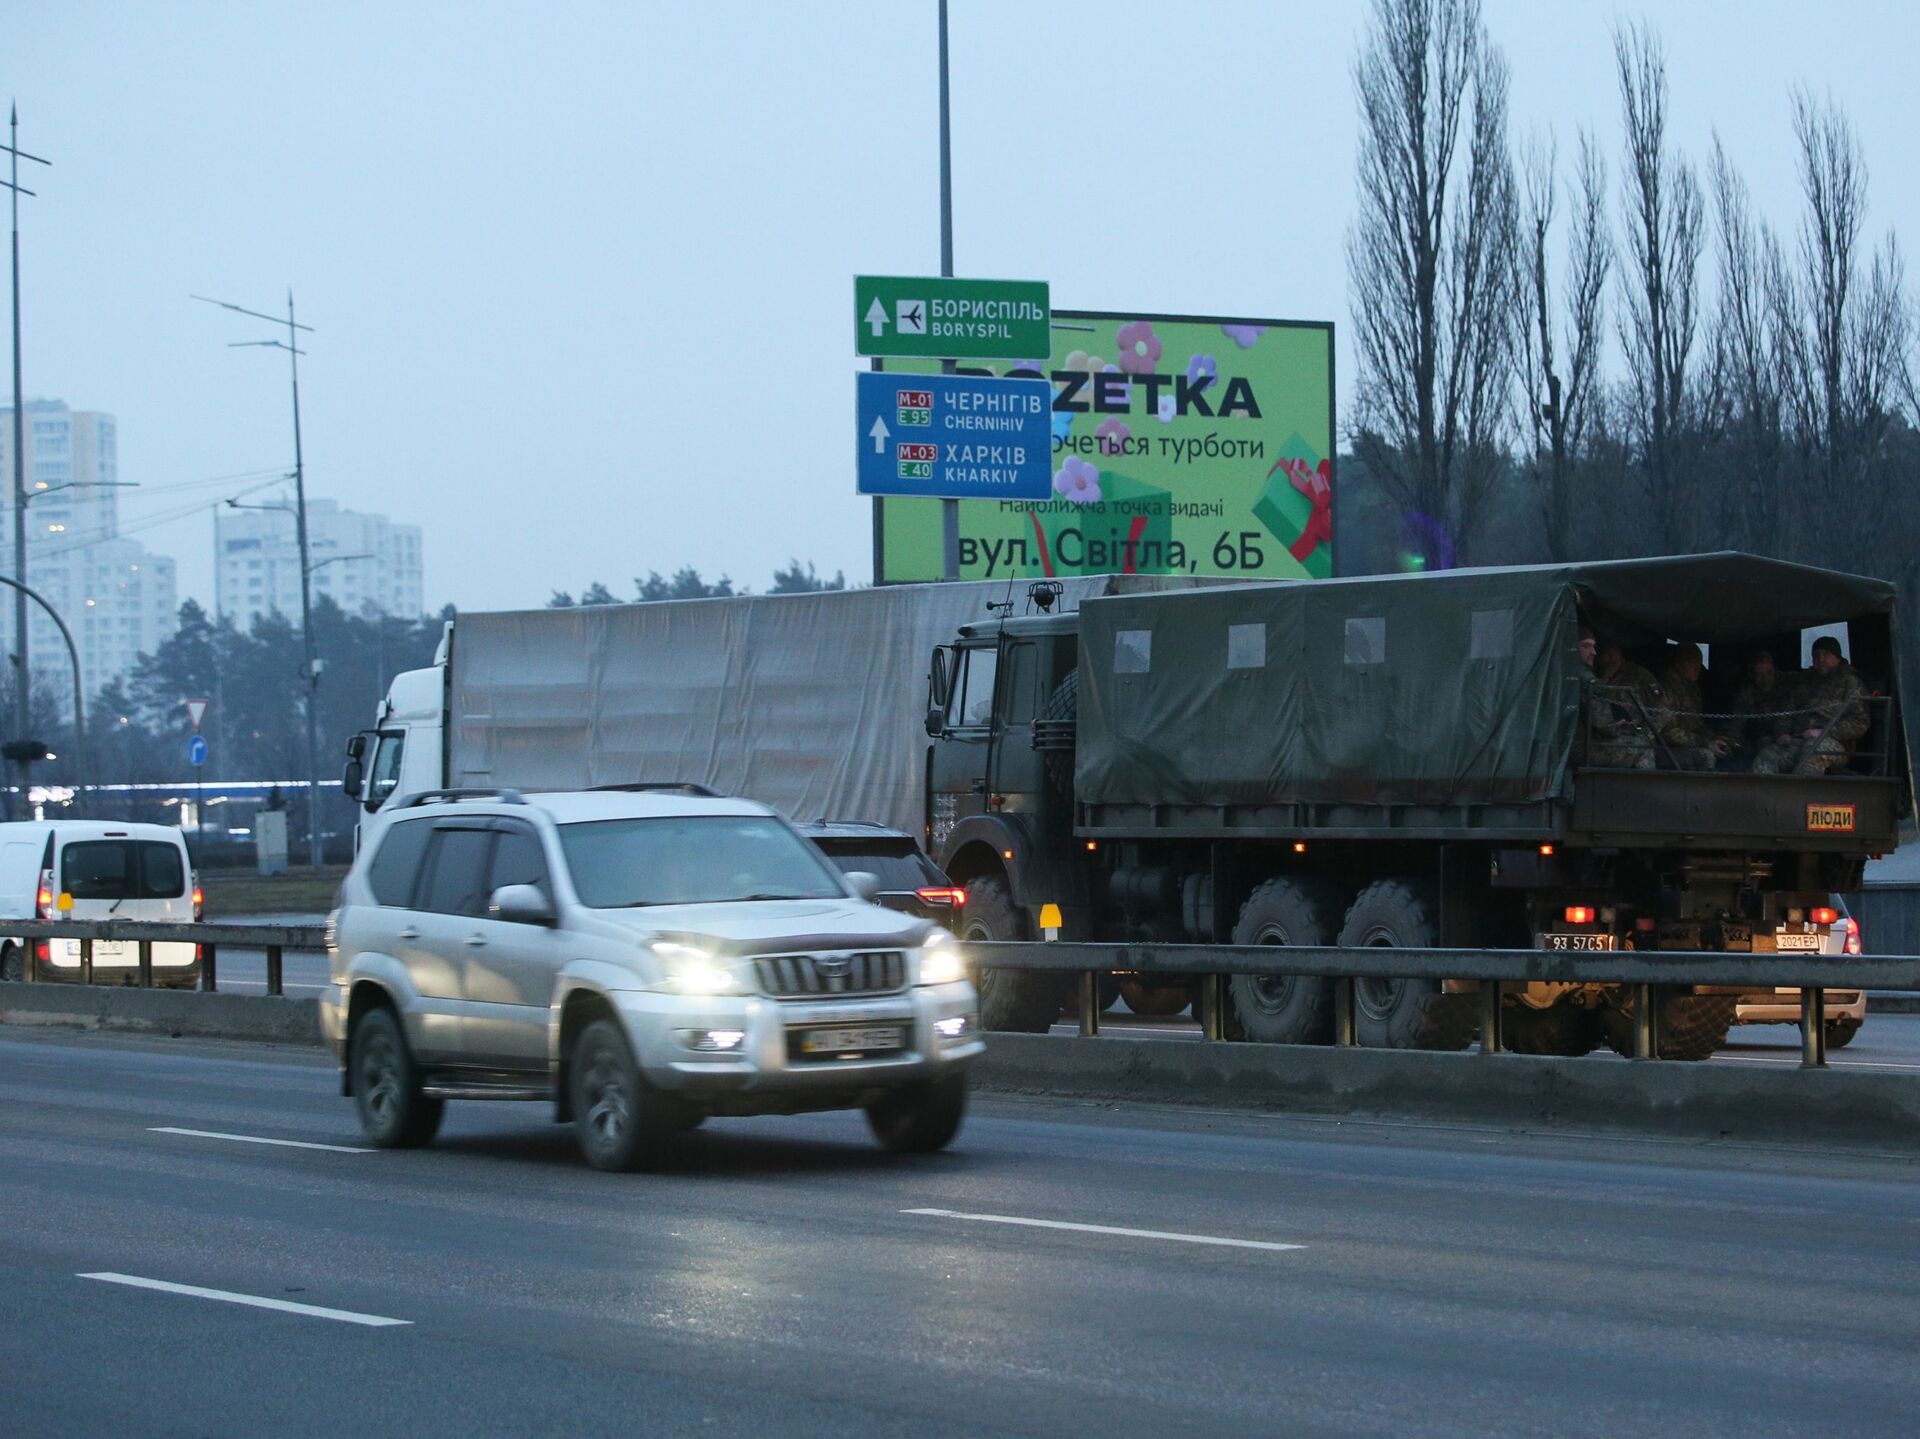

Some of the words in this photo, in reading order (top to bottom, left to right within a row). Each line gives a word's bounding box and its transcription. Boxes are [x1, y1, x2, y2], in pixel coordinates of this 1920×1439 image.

[931, 299, 1044, 321] БОРИСПІЛЬ
[932, 322, 1013, 339] BORYSPIL
[899, 392, 932, 407] M-01
[955, 367, 1263, 419] ZETKA
[944, 391, 1042, 414] ЧЕРНІГІВ
[899, 410, 908, 423] E
[911, 410, 929, 424] 95
[944, 414, 1025, 432] CHERNIHIV
[899, 445, 936, 460] M-03
[945, 444, 1026, 465] ХАРКІВ
[1158, 432, 1264, 464] турботи
[900, 462, 908, 476] E
[912, 463, 930, 477] 40
[944, 467, 1018, 484] KHARKIV
[1112, 500, 1162, 517] точка
[1168, 498, 1224, 518] видачі
[959, 537, 1039, 577] вул.
[1056, 528, 1198, 573] Світла,
[1213, 531, 1264, 569] 6Б
[1811, 810, 1851, 828] ЛЮДИ
